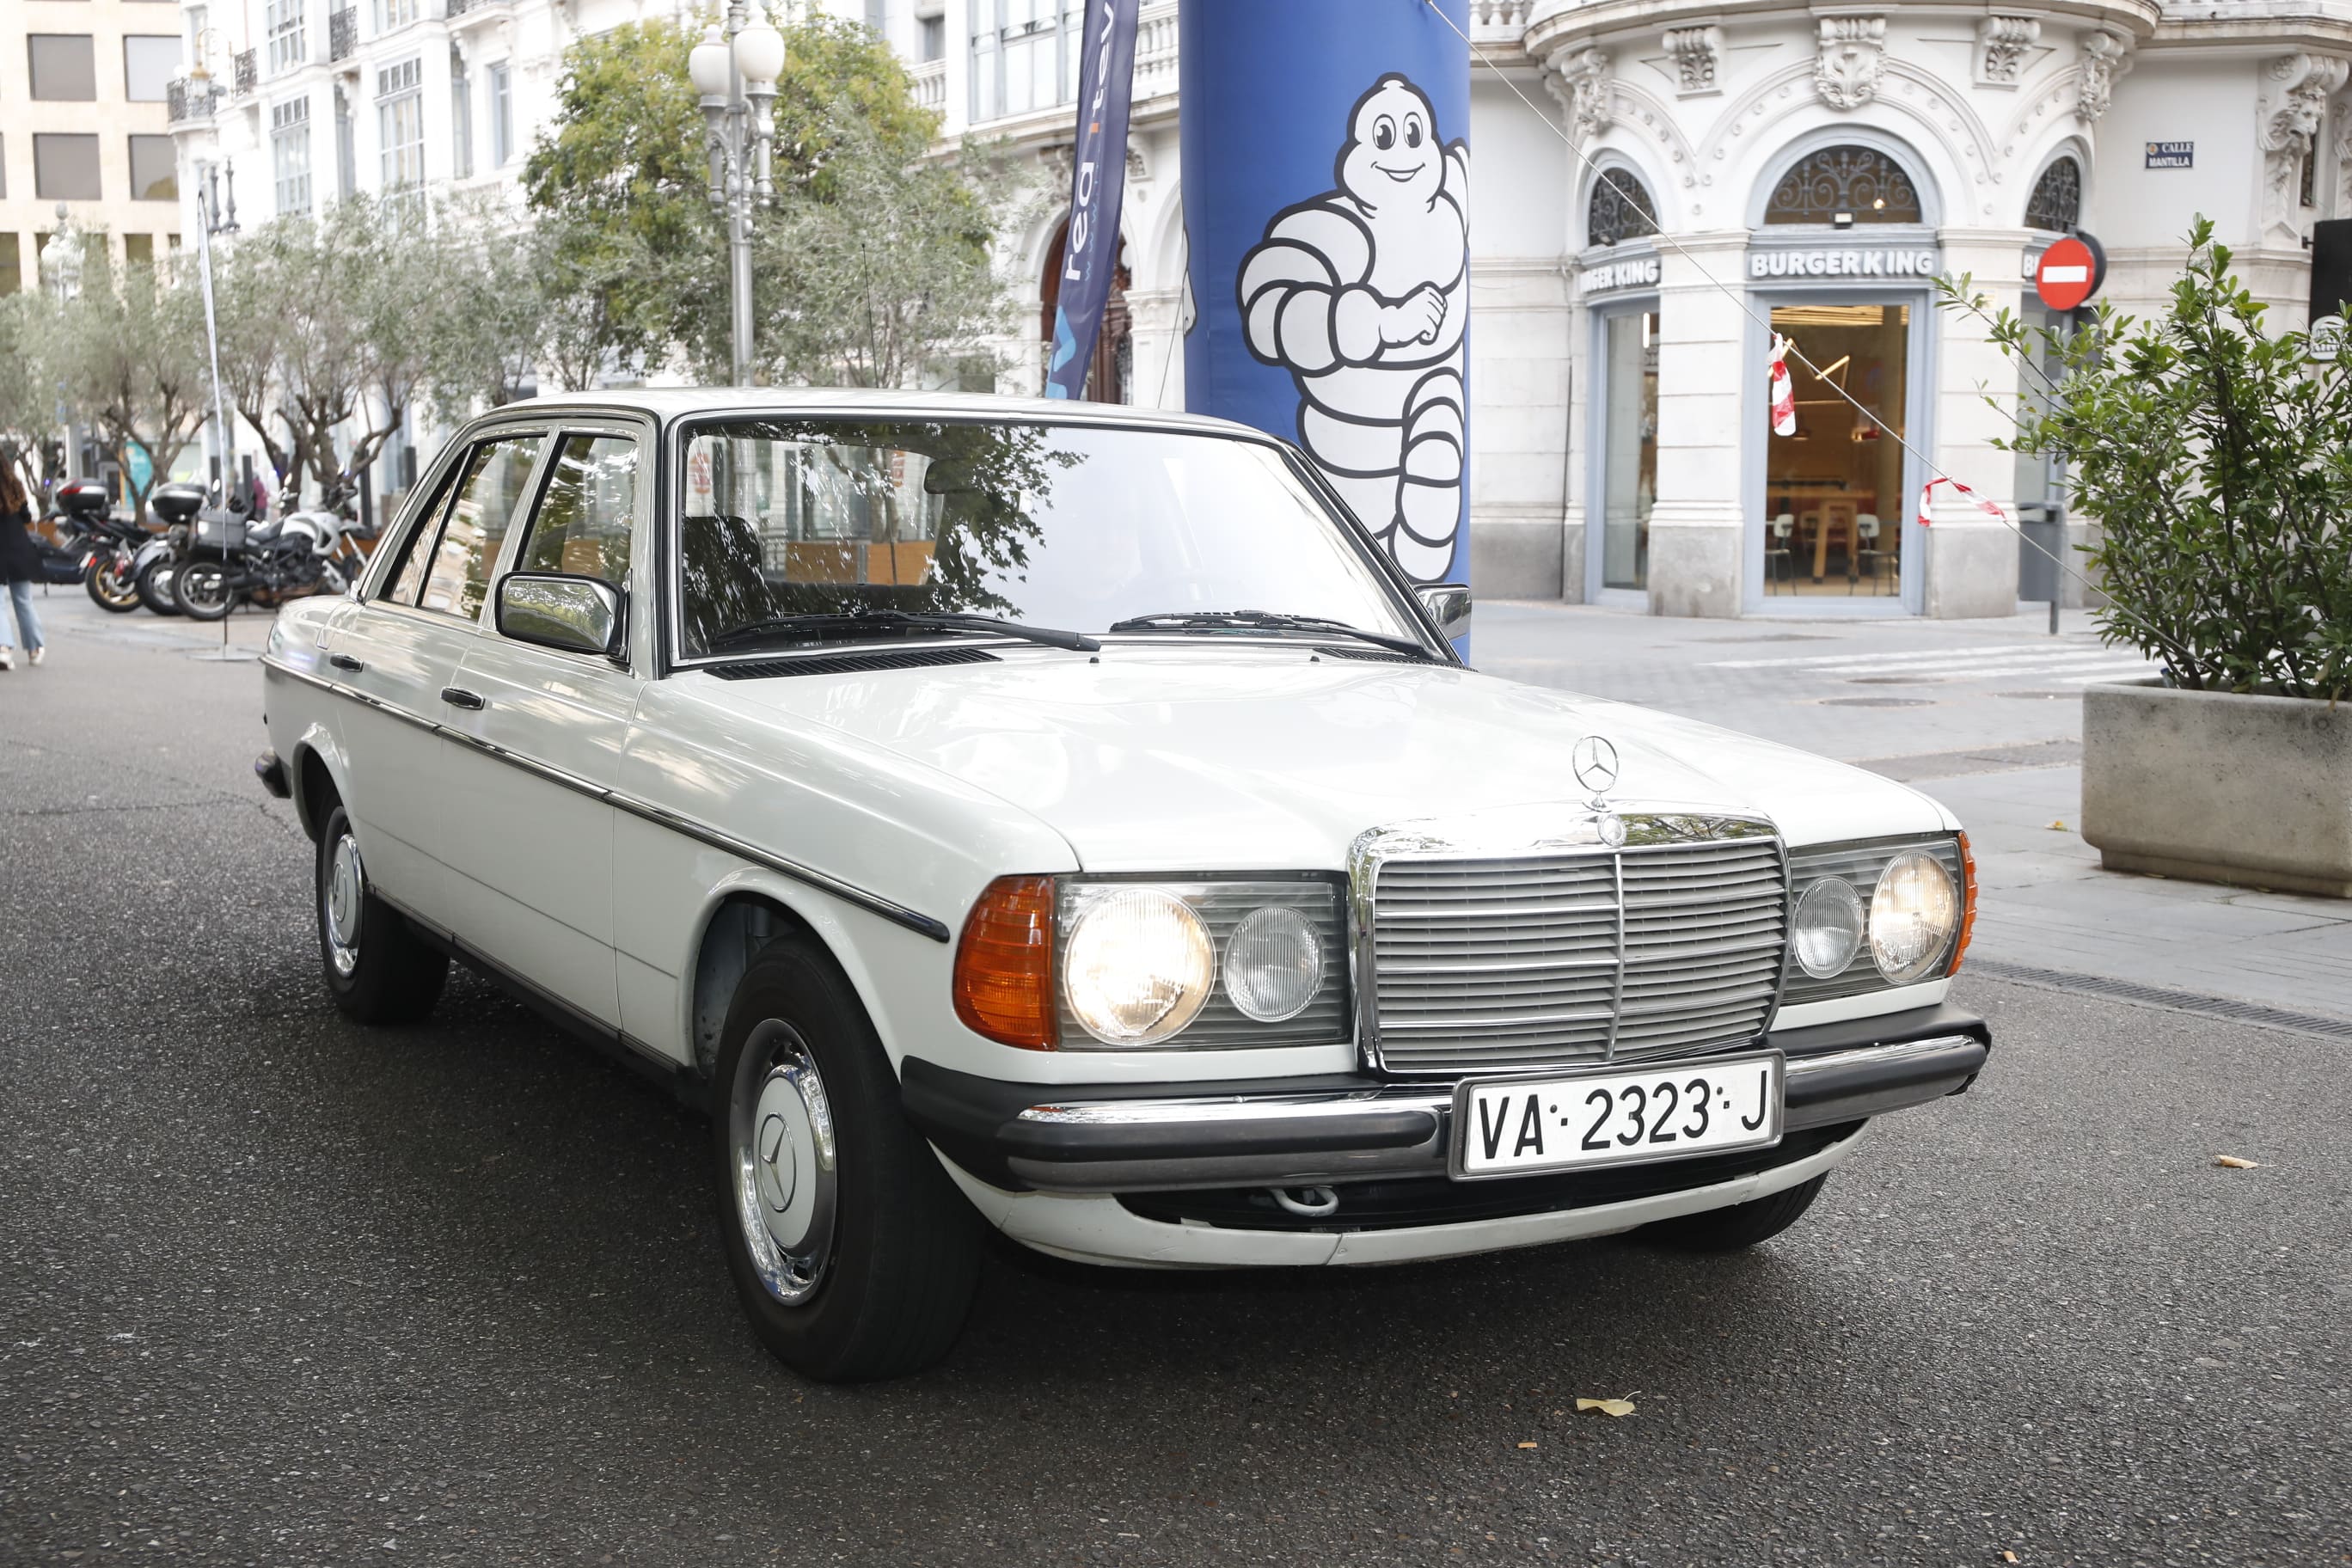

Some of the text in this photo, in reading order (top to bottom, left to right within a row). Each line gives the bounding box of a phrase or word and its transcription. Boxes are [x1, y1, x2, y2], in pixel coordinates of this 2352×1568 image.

[2161, 143, 2193, 153] CALLE
[2149, 156, 2190, 167] MANTILLA
[1615, 260, 1658, 286] KING
